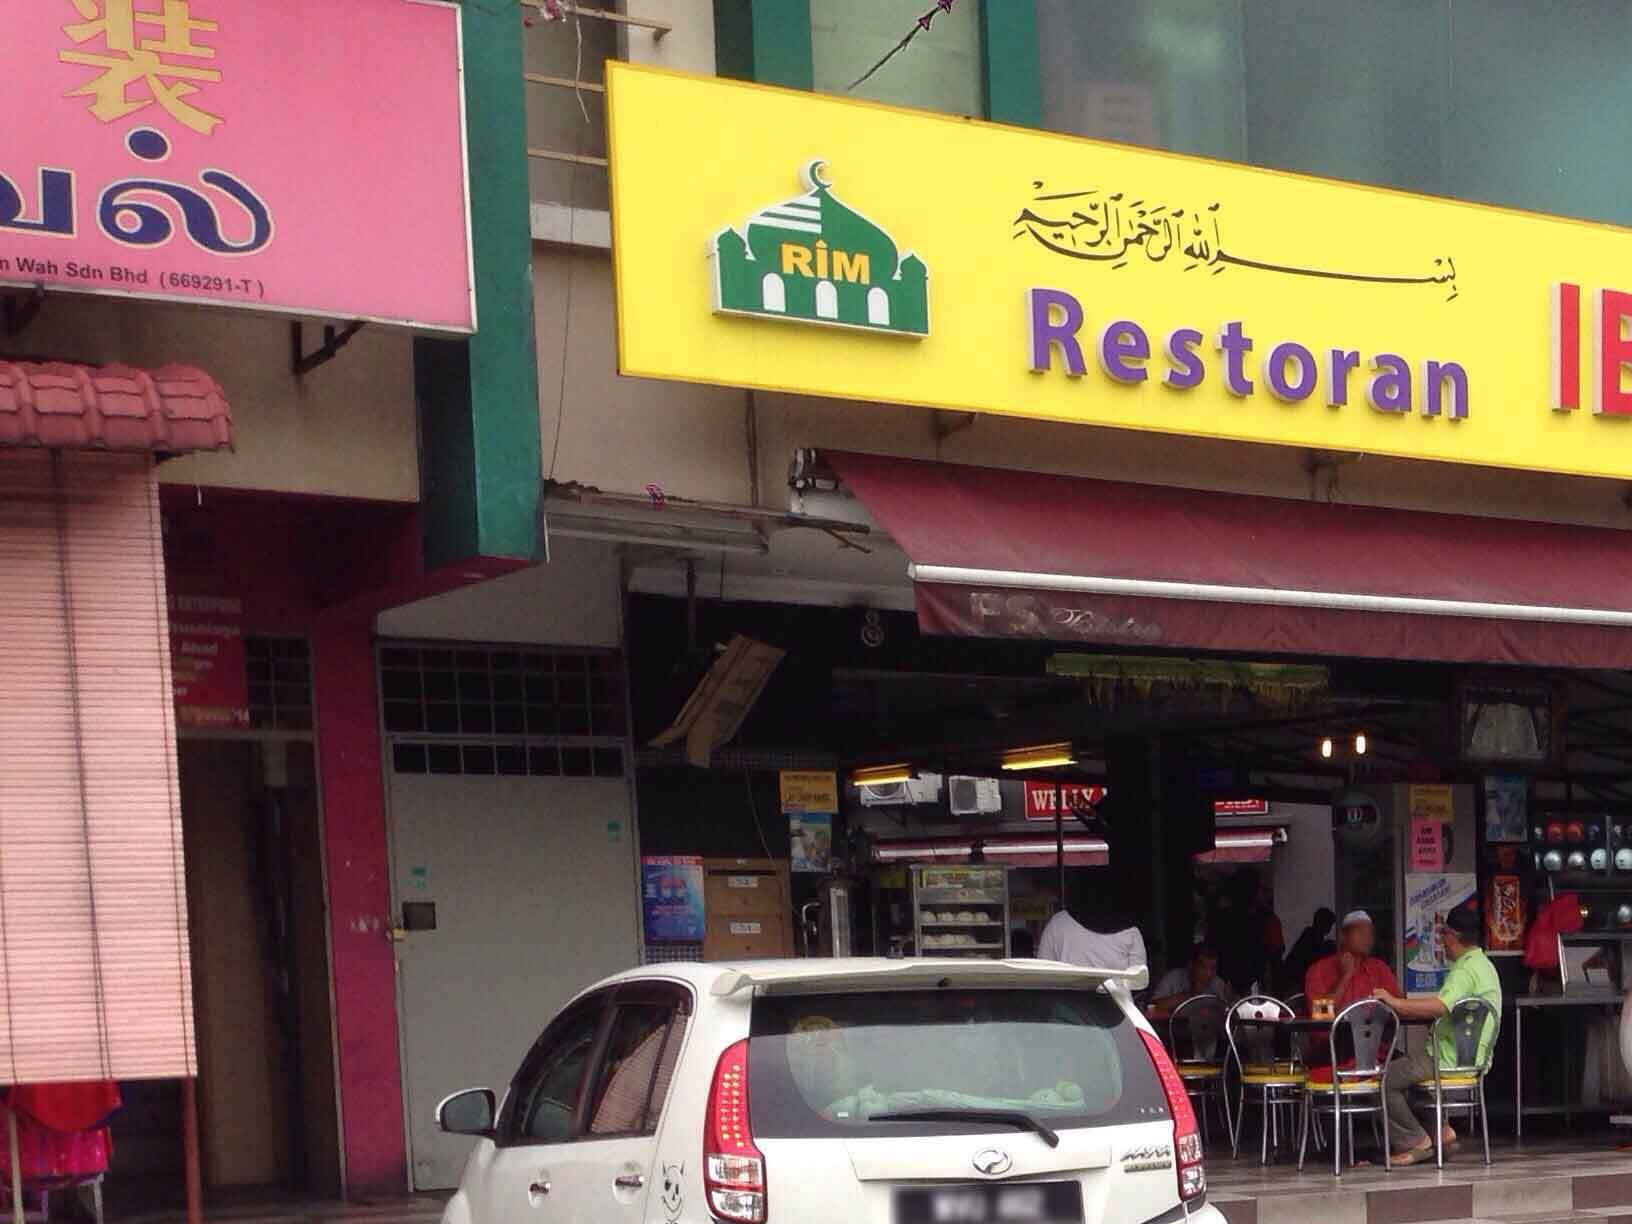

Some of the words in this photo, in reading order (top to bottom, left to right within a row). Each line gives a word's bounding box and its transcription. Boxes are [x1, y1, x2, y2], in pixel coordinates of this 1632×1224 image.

[16, 257, 58, 276] Wah
[65, 261, 103, 280] Sdn
[110, 266, 148, 284] Bhd
[1026, 287, 1470, 421] Restoran
